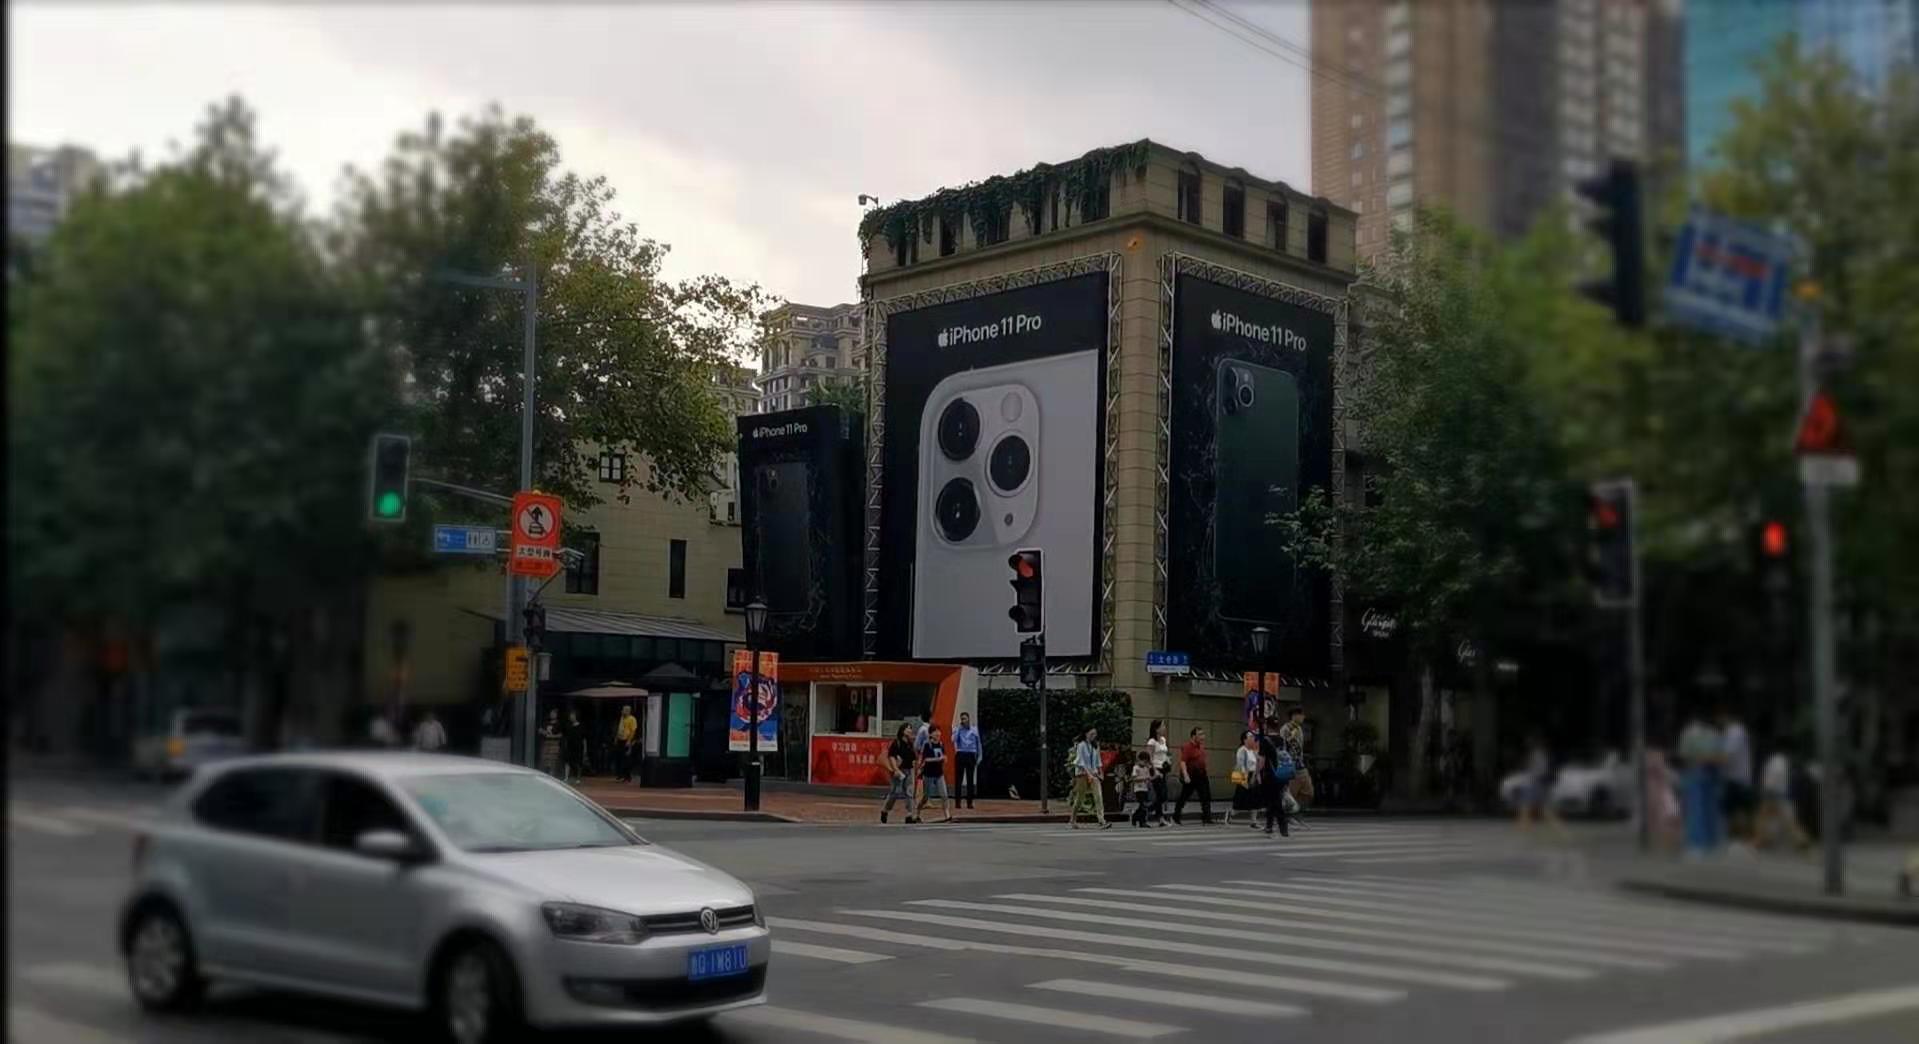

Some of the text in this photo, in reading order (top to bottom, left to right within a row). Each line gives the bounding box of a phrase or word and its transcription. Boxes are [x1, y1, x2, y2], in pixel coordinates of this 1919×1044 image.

[950, 314, 1041, 346] iPhone 11 Pro
[1222, 312, 1306, 351] iPhone 11 Pro
[759, 422, 808, 438] iPhone 11 Pro
